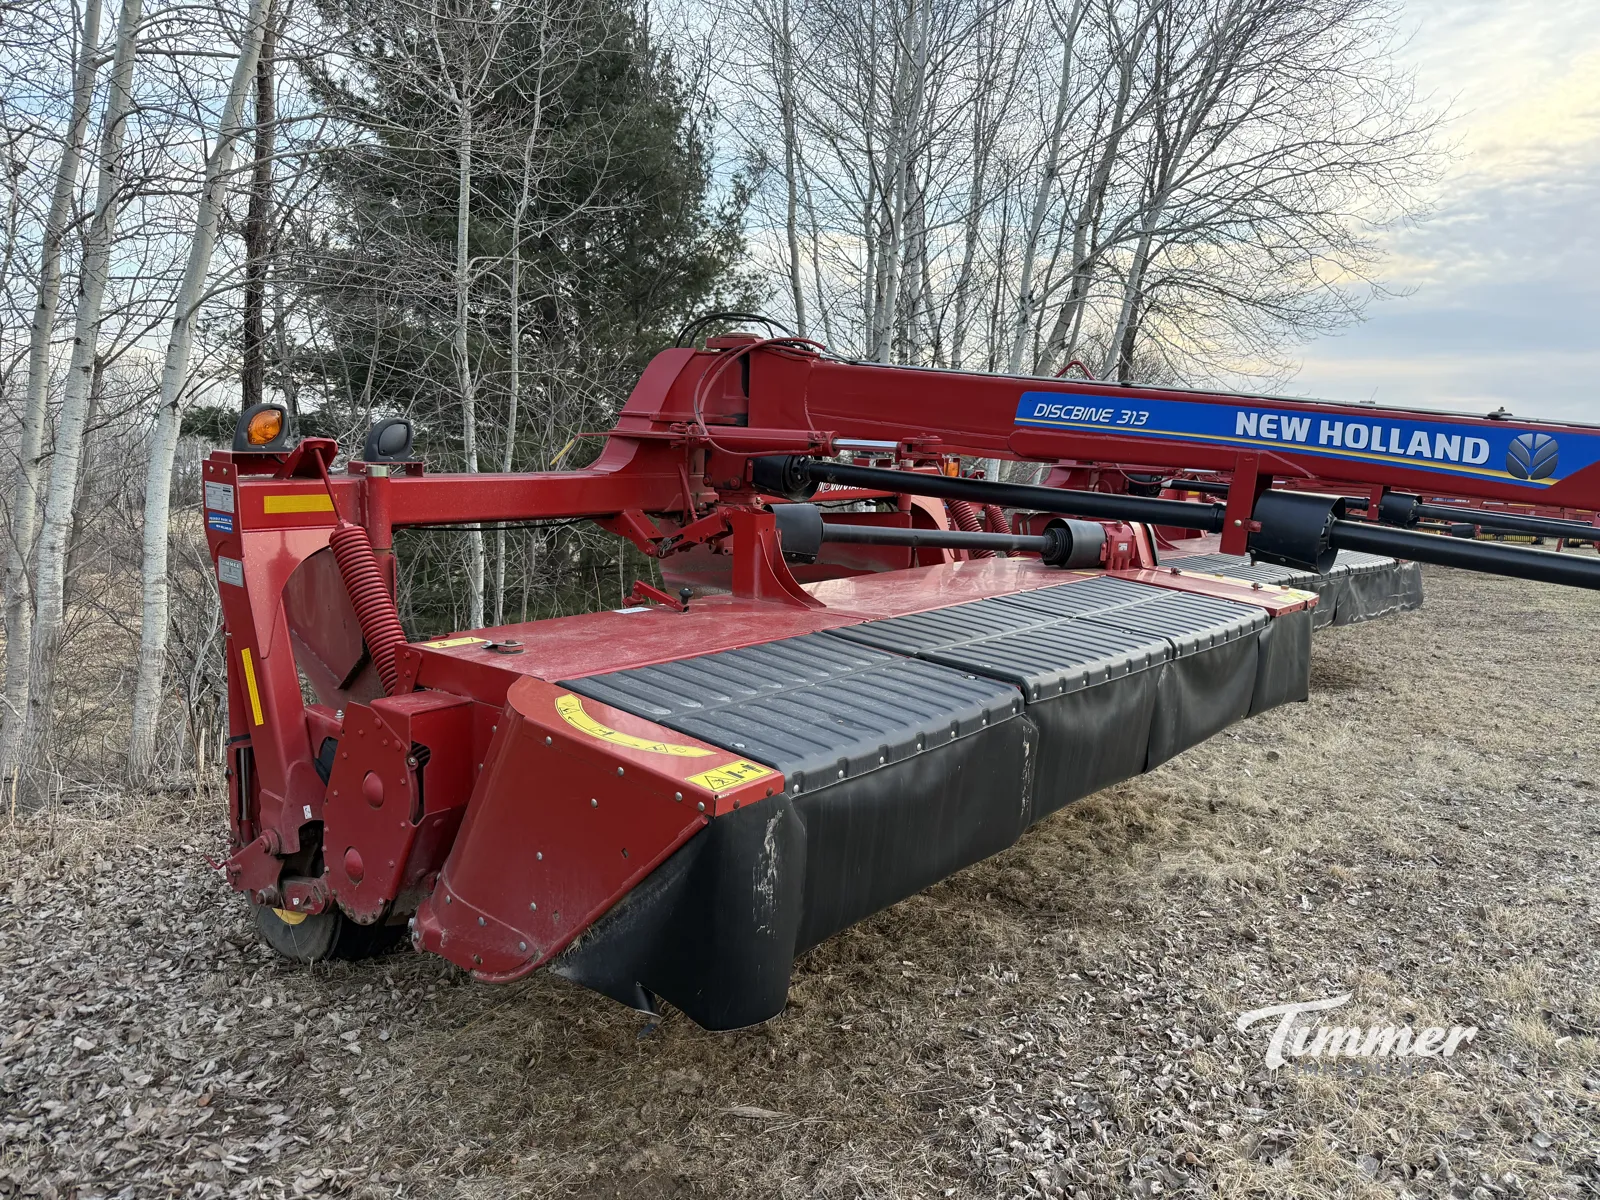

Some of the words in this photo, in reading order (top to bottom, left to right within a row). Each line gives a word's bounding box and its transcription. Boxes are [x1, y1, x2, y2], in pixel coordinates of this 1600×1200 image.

[1033, 403, 1114, 423] DISCBINE
[1116, 409, 1149, 426] 313
[1235, 411, 1312, 443] NEW
[1318, 419, 1490, 465] HOLLAND
